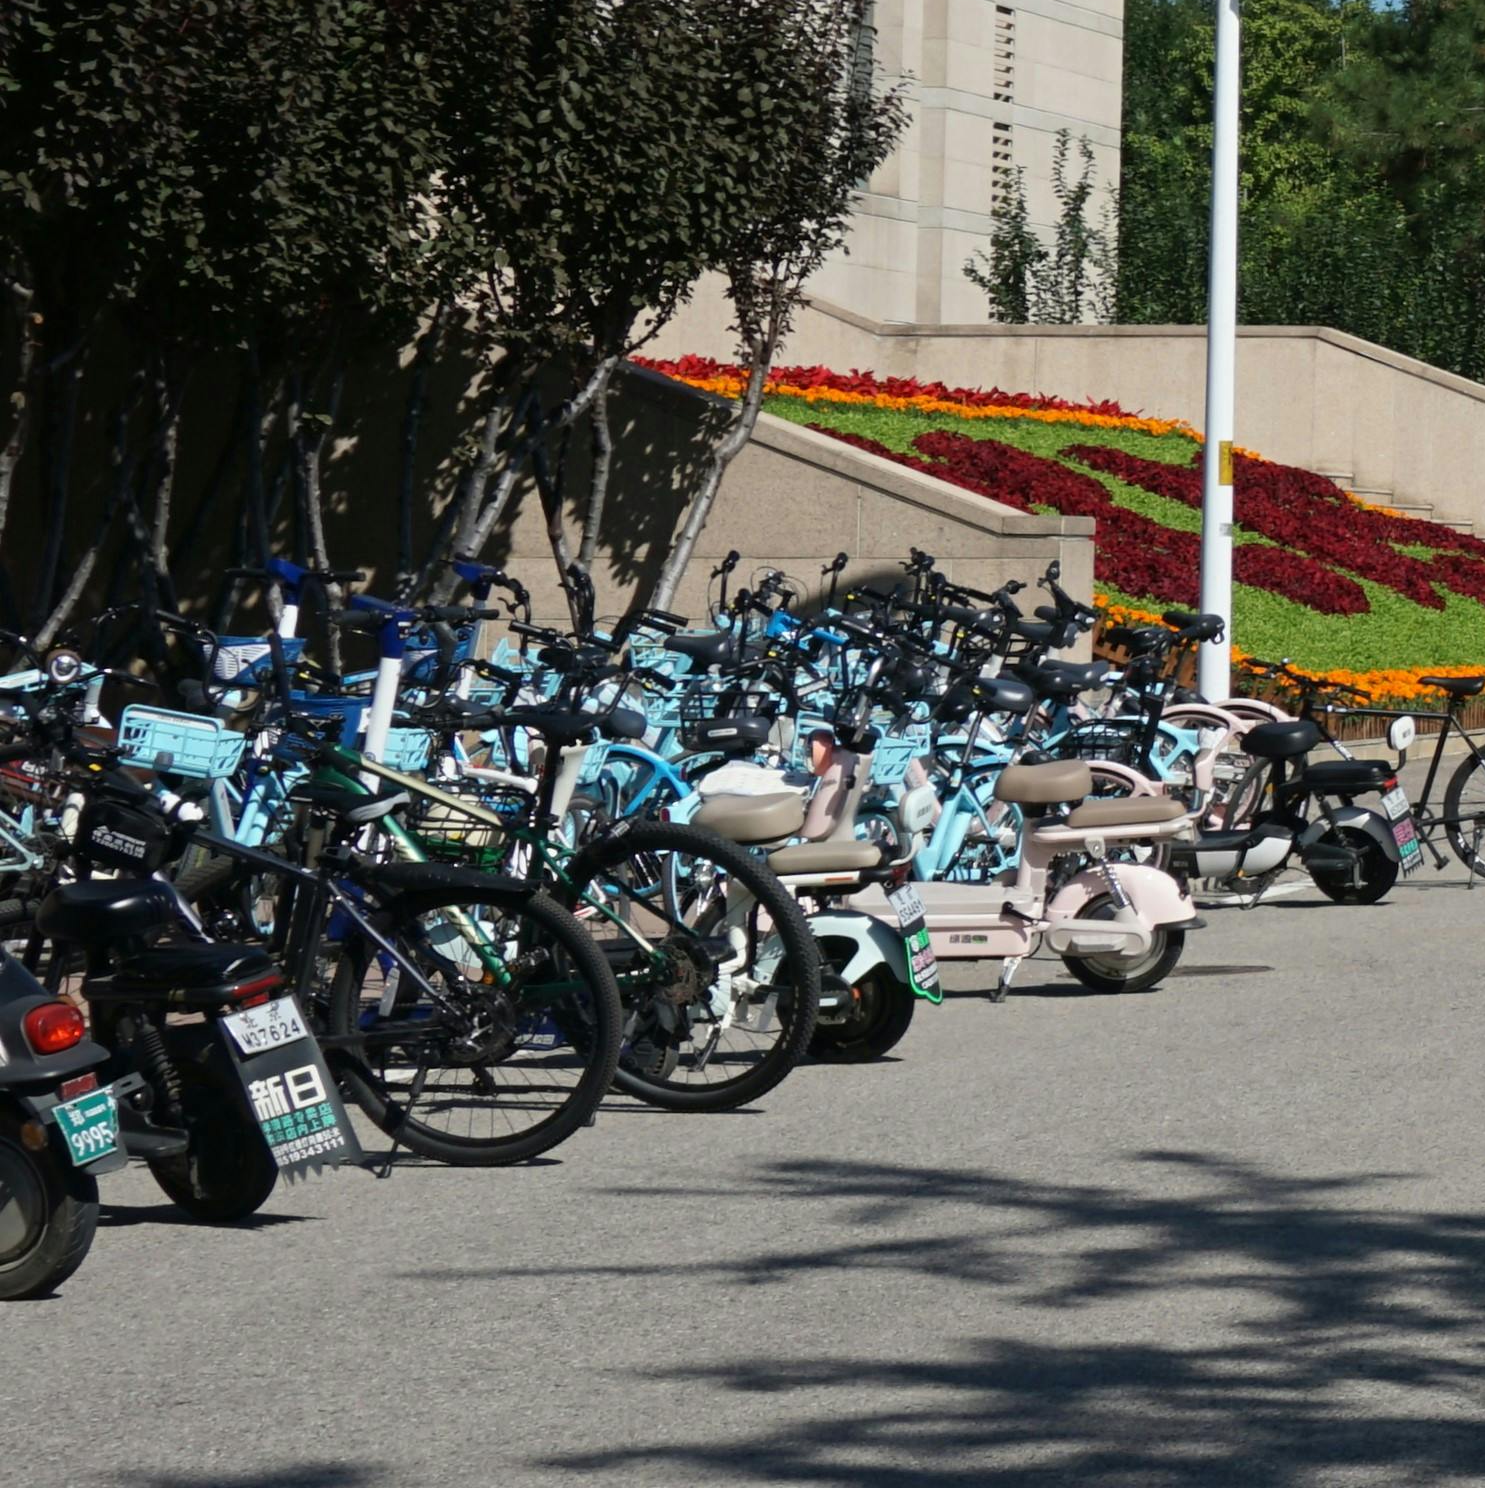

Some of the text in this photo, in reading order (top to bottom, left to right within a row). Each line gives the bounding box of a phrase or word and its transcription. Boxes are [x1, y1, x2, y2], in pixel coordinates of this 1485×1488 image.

[242, 1018, 301, 1050] W37624
[248, 1063, 327, 1122] 新日
[71, 1120, 115, 1157] 9995
